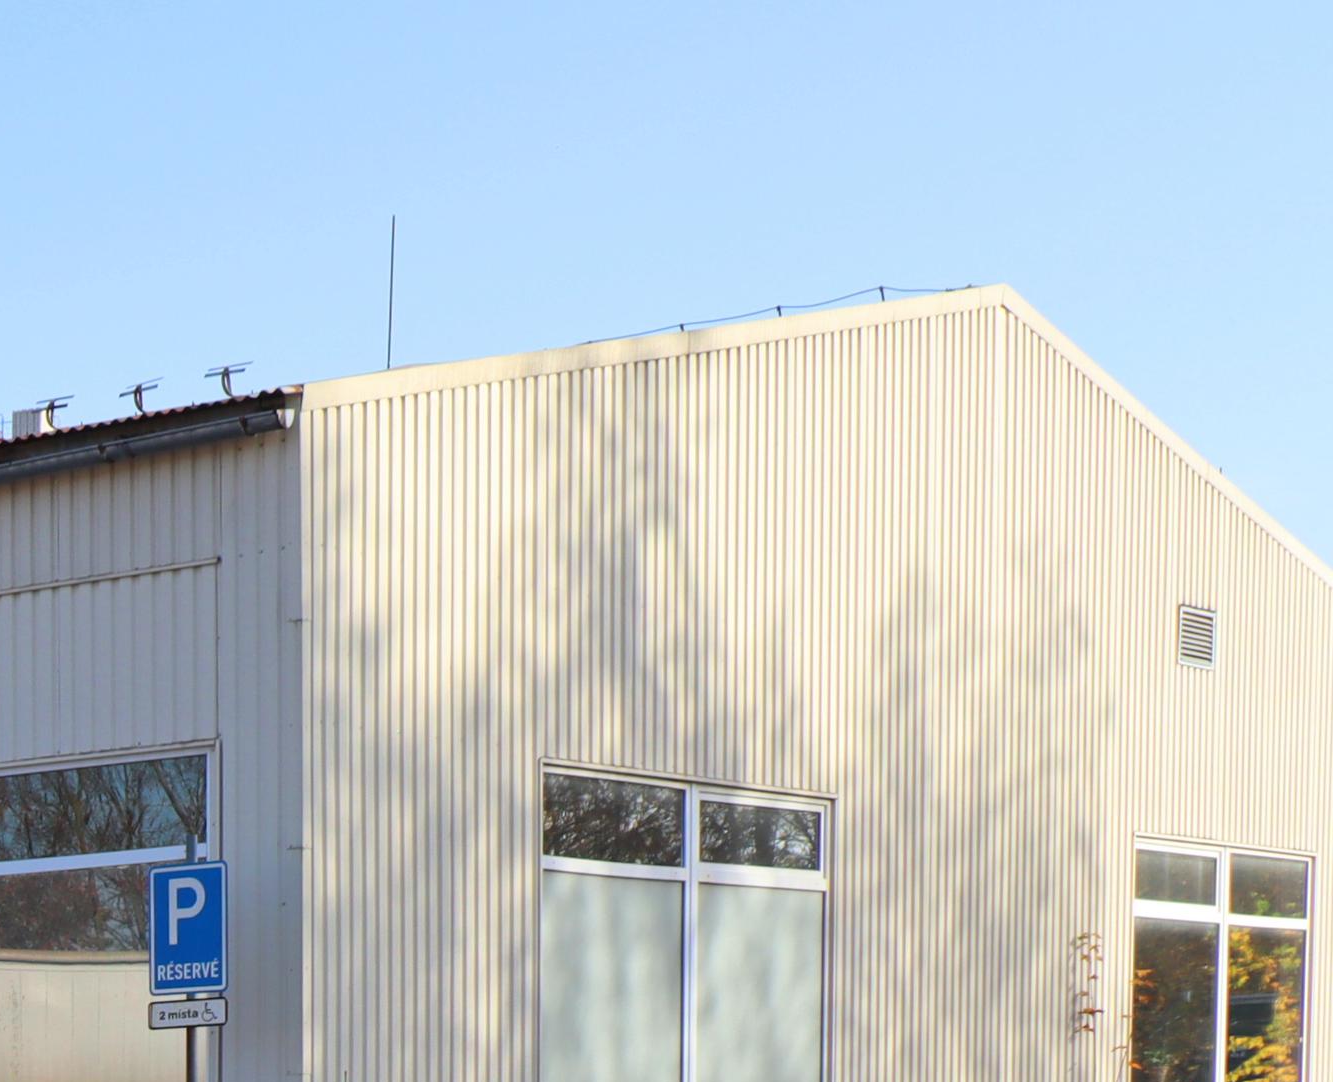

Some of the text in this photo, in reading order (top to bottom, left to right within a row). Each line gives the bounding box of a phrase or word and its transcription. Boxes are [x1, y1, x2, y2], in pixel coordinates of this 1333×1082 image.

[168, 877, 206, 945] P
[157, 958, 219, 982] RÉSERVÉ
[159, 1011, 166, 1020] 2
